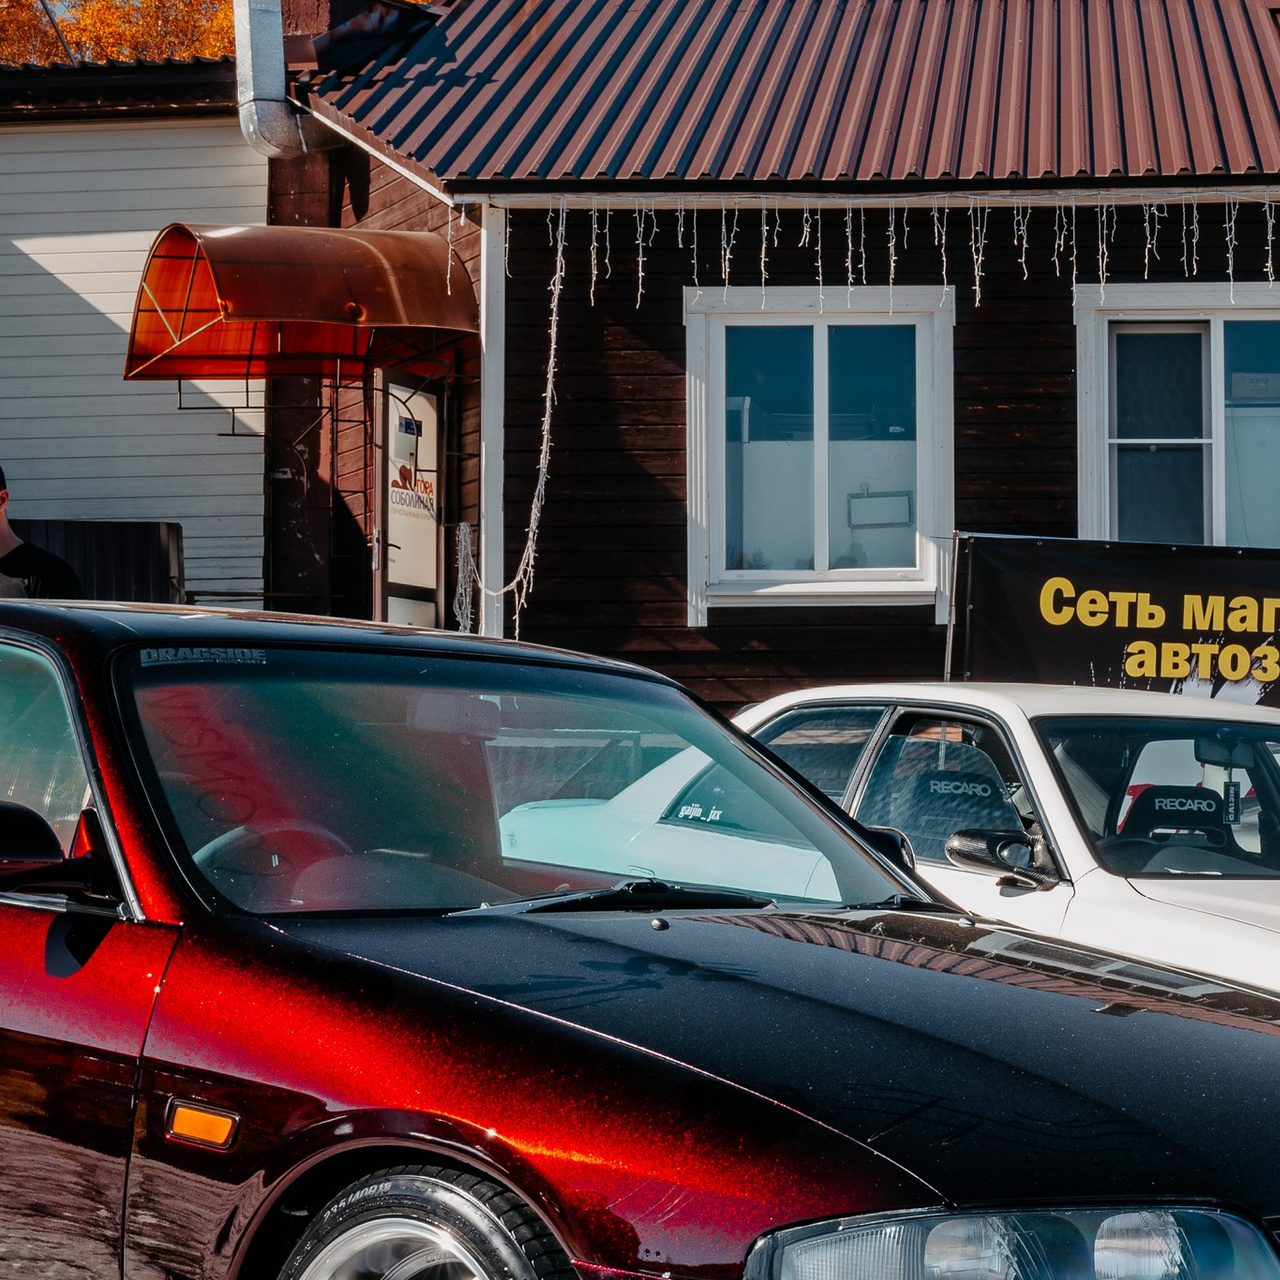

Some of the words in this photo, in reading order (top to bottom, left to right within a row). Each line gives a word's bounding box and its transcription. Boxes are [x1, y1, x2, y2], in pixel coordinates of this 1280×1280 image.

[416, 479, 434, 496] ГОРА
[390, 489, 435, 512] СОБОЛИНАЯ
[1039, 576, 1166, 629] Сеть
[140, 647, 267, 662] DRAGSIDE
[929, 780, 991, 797] RECARO
[1154, 798, 1217, 812] RECARO
